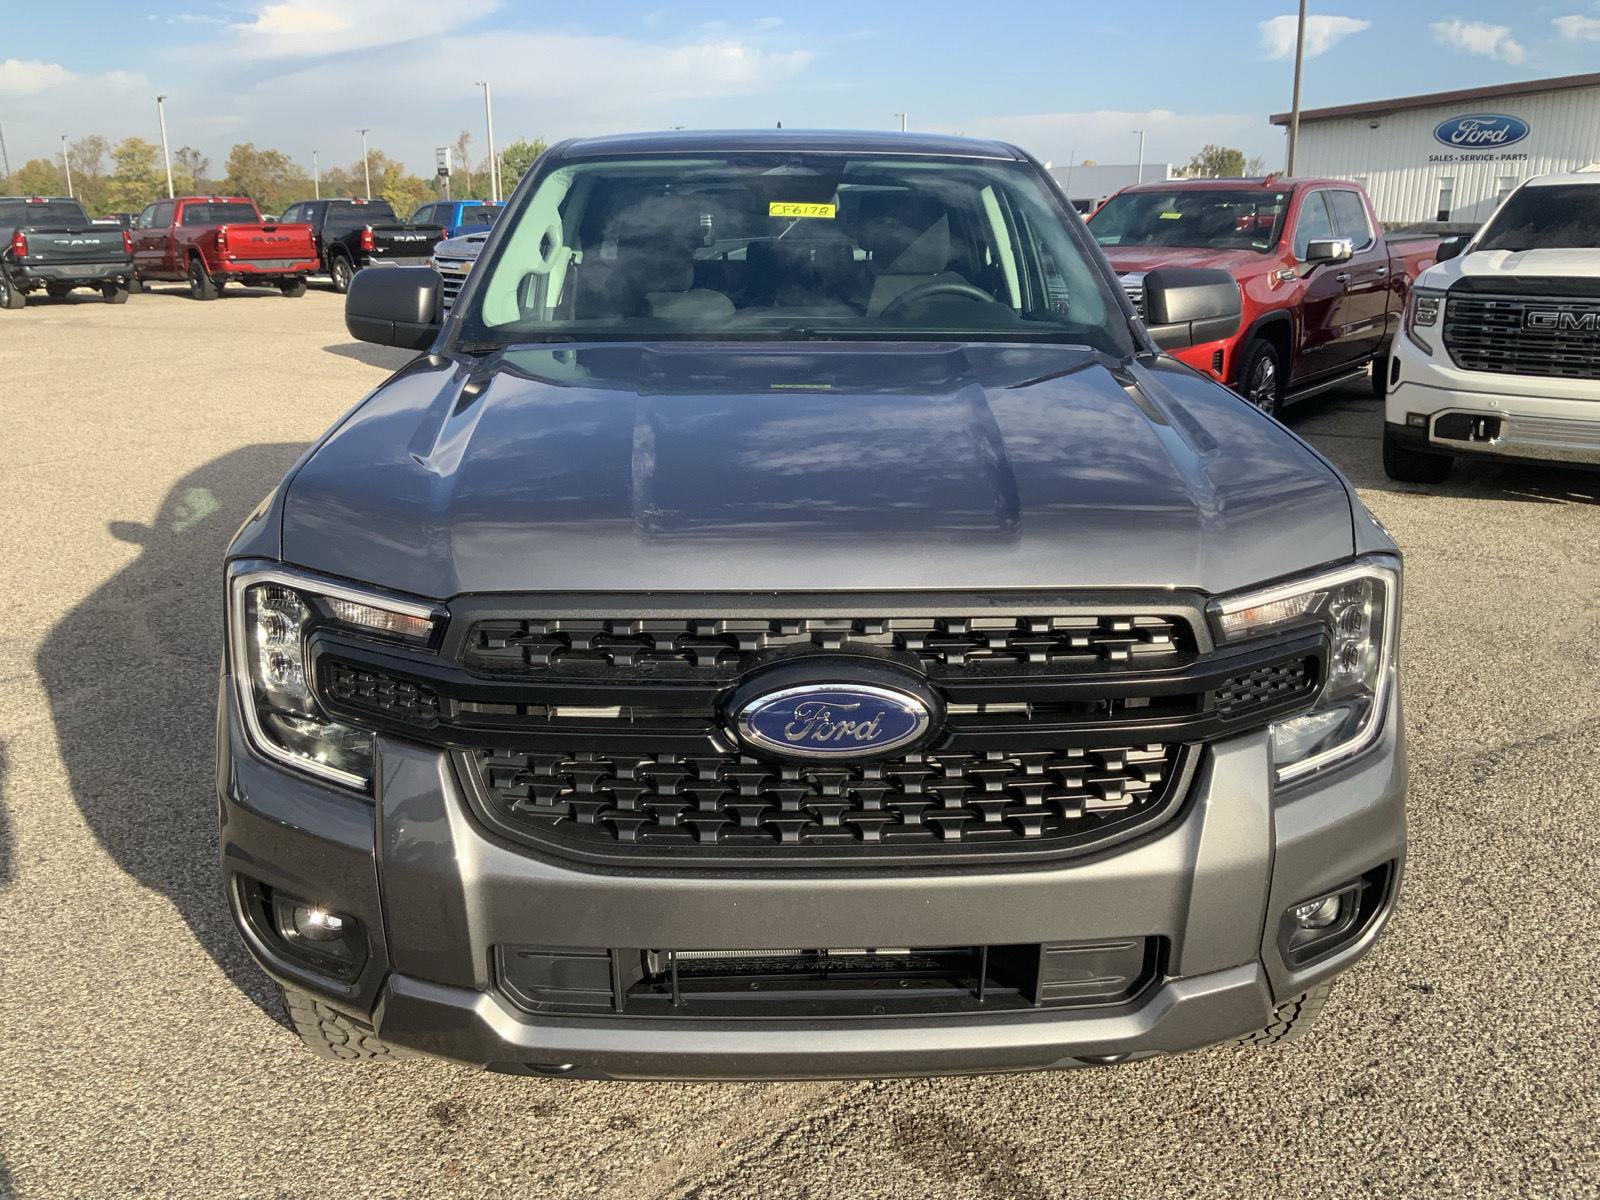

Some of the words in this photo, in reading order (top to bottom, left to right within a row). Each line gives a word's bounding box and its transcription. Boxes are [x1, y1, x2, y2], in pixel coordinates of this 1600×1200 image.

[1451, 119, 1511, 143] Ford
[1428, 154, 1454, 162] SALES
[1459, 153, 1494, 161] SERVICE
[1500, 153, 1528, 161] PARTS
[770, 204, 830, 216] CF6178
[1527, 311, 1600, 330] GM
[784, 701, 885, 741] Ford
